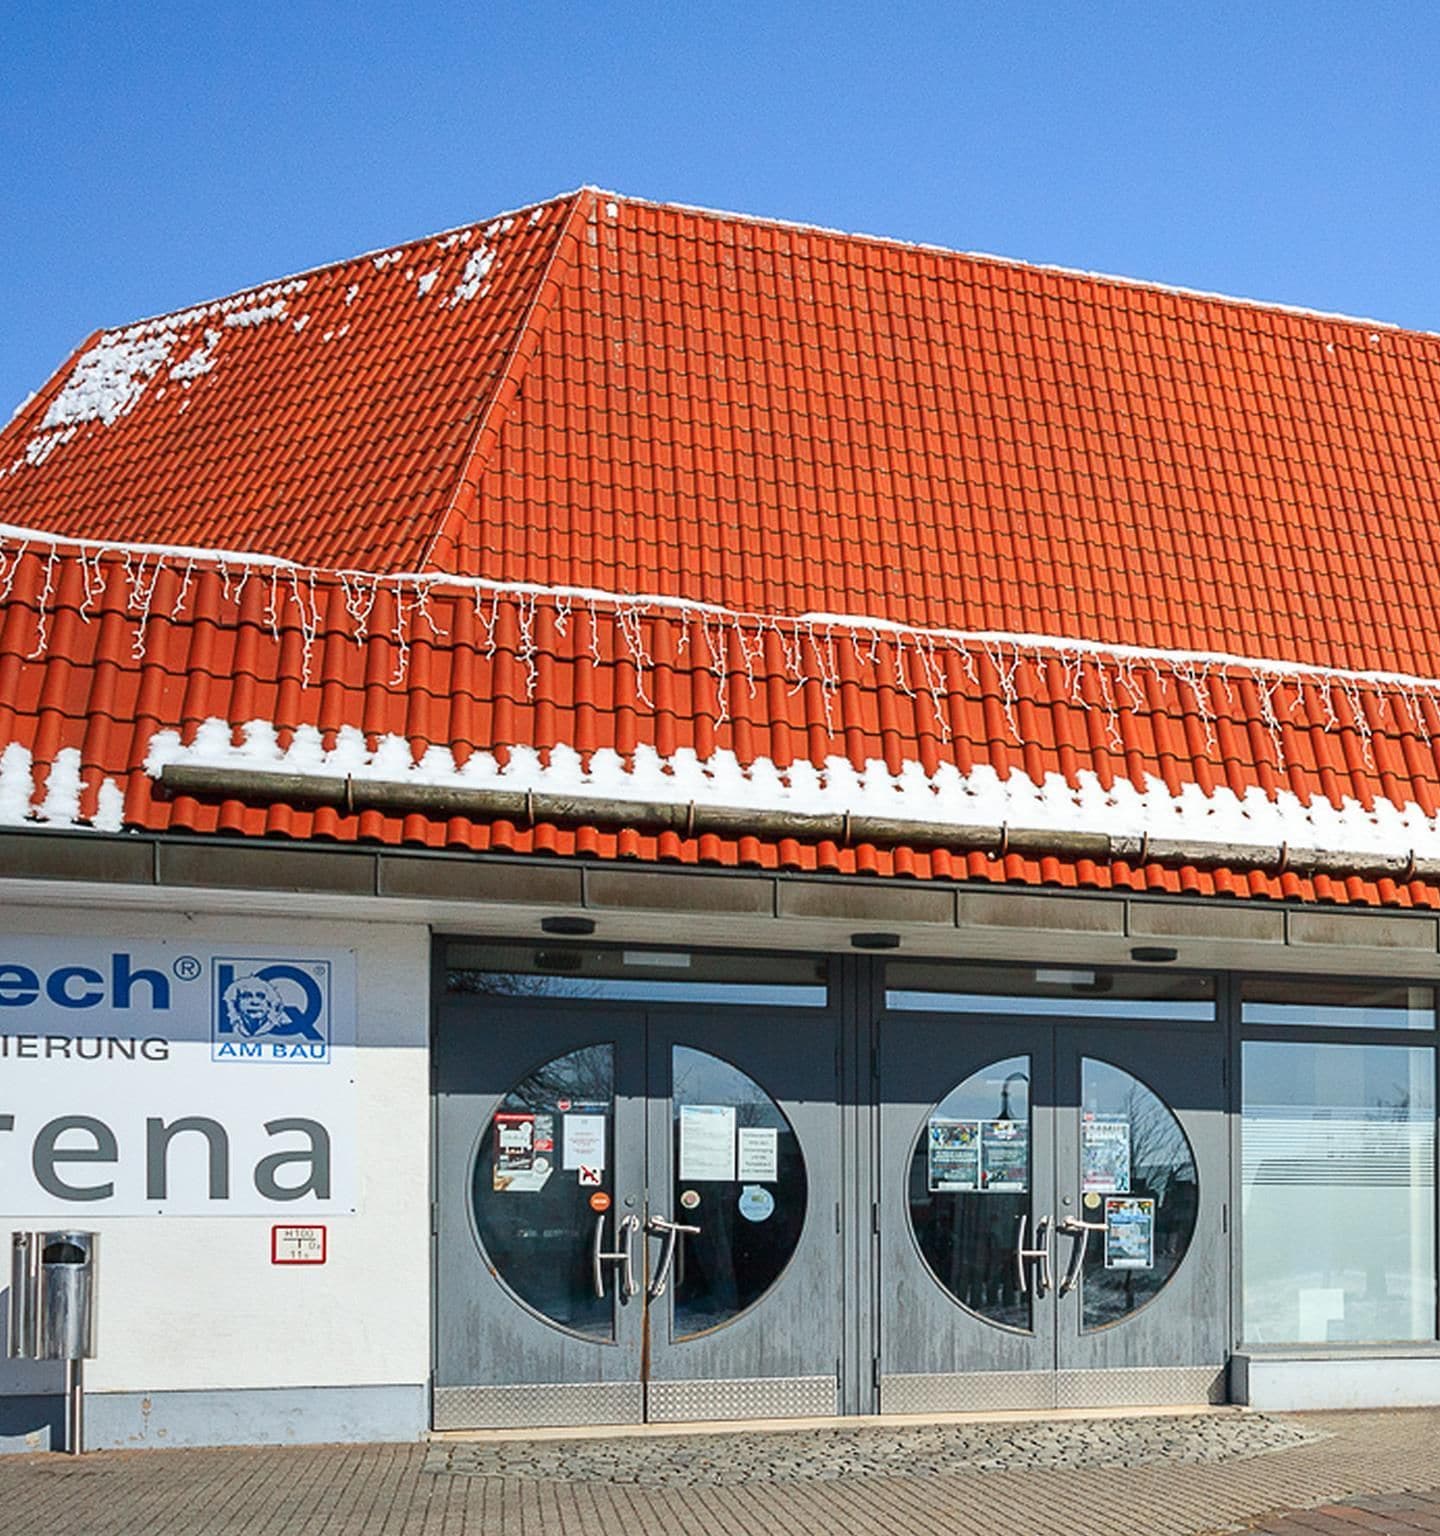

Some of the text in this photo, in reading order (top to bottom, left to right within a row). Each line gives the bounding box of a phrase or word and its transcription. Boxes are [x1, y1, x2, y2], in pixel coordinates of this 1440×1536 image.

[2, 1034, 170, 1061] IERUNG
[218, 1042, 326, 1058] AM BAU
